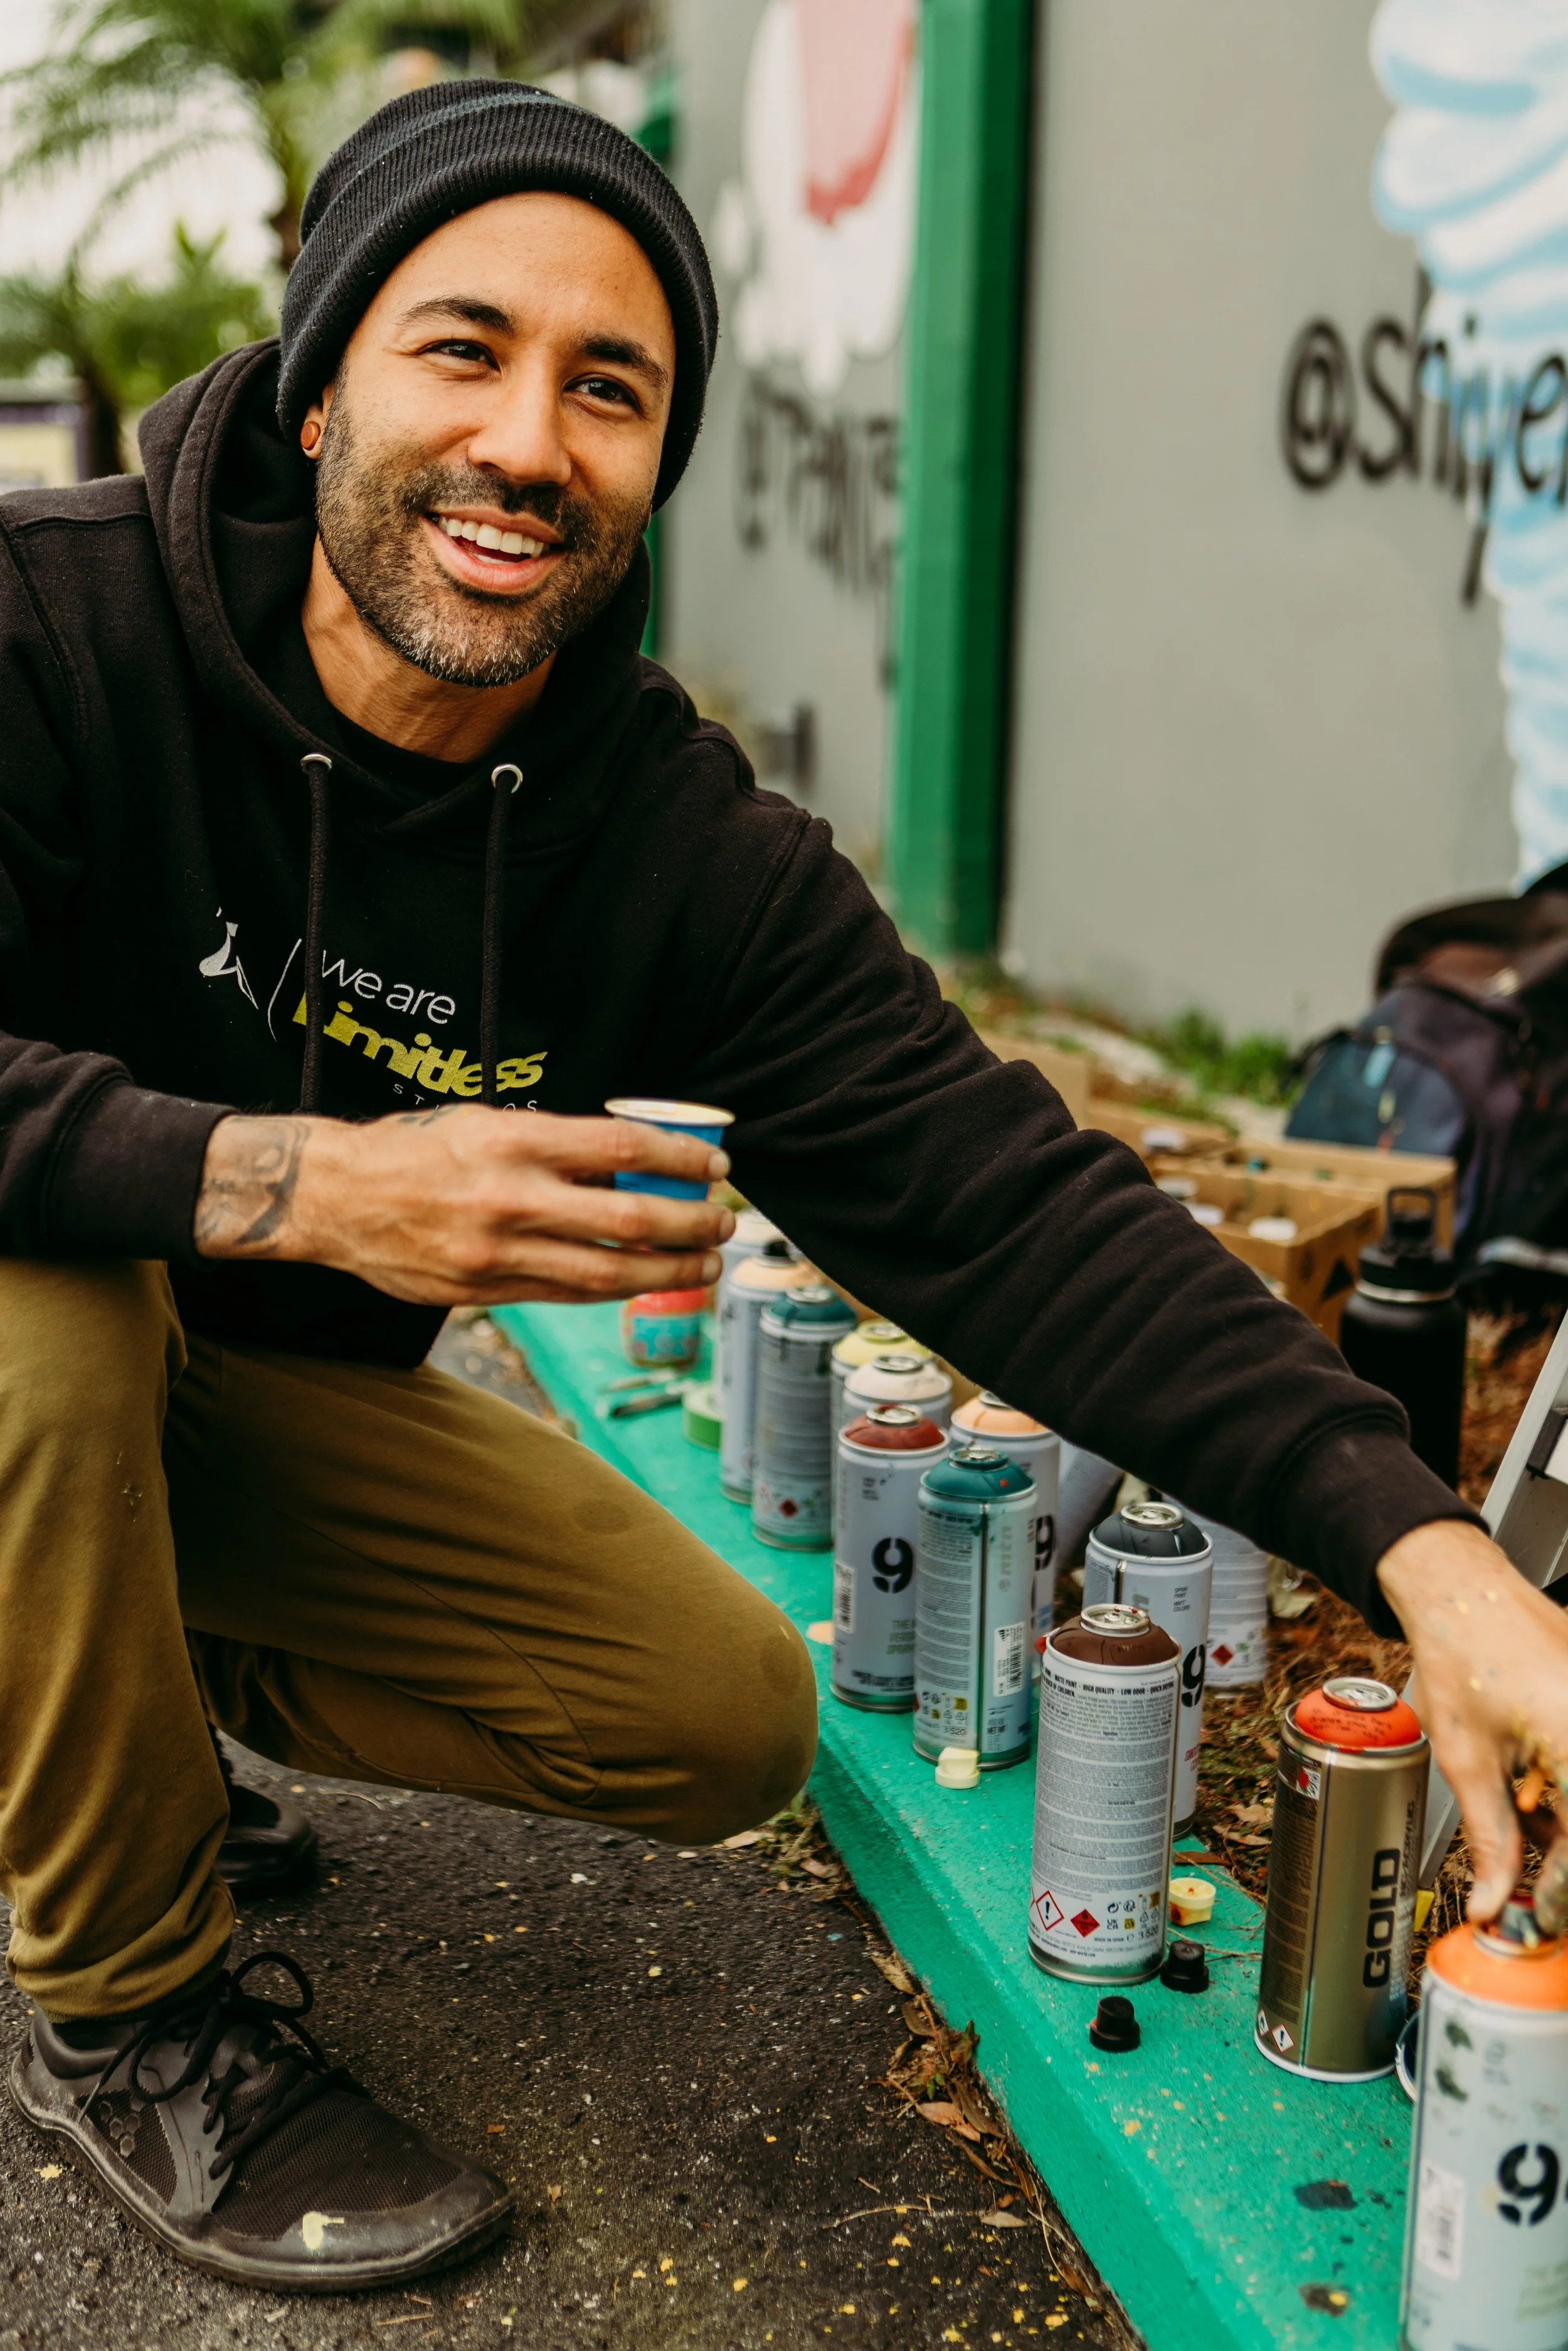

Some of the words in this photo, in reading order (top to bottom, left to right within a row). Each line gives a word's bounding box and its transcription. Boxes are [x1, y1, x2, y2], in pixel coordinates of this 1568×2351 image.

[322, 949, 383, 999] we
[386, 984, 455, 1024] are
[393, 1083, 538, 1114] STOS
[871, 1537, 914, 1594] 9
[1095, 1686, 1115, 1695] QUALITY
[1181, 1643, 1205, 1707] 9
[1362, 1849, 1401, 1988] GOLD
[1498, 2142, 1568, 2227] 9
